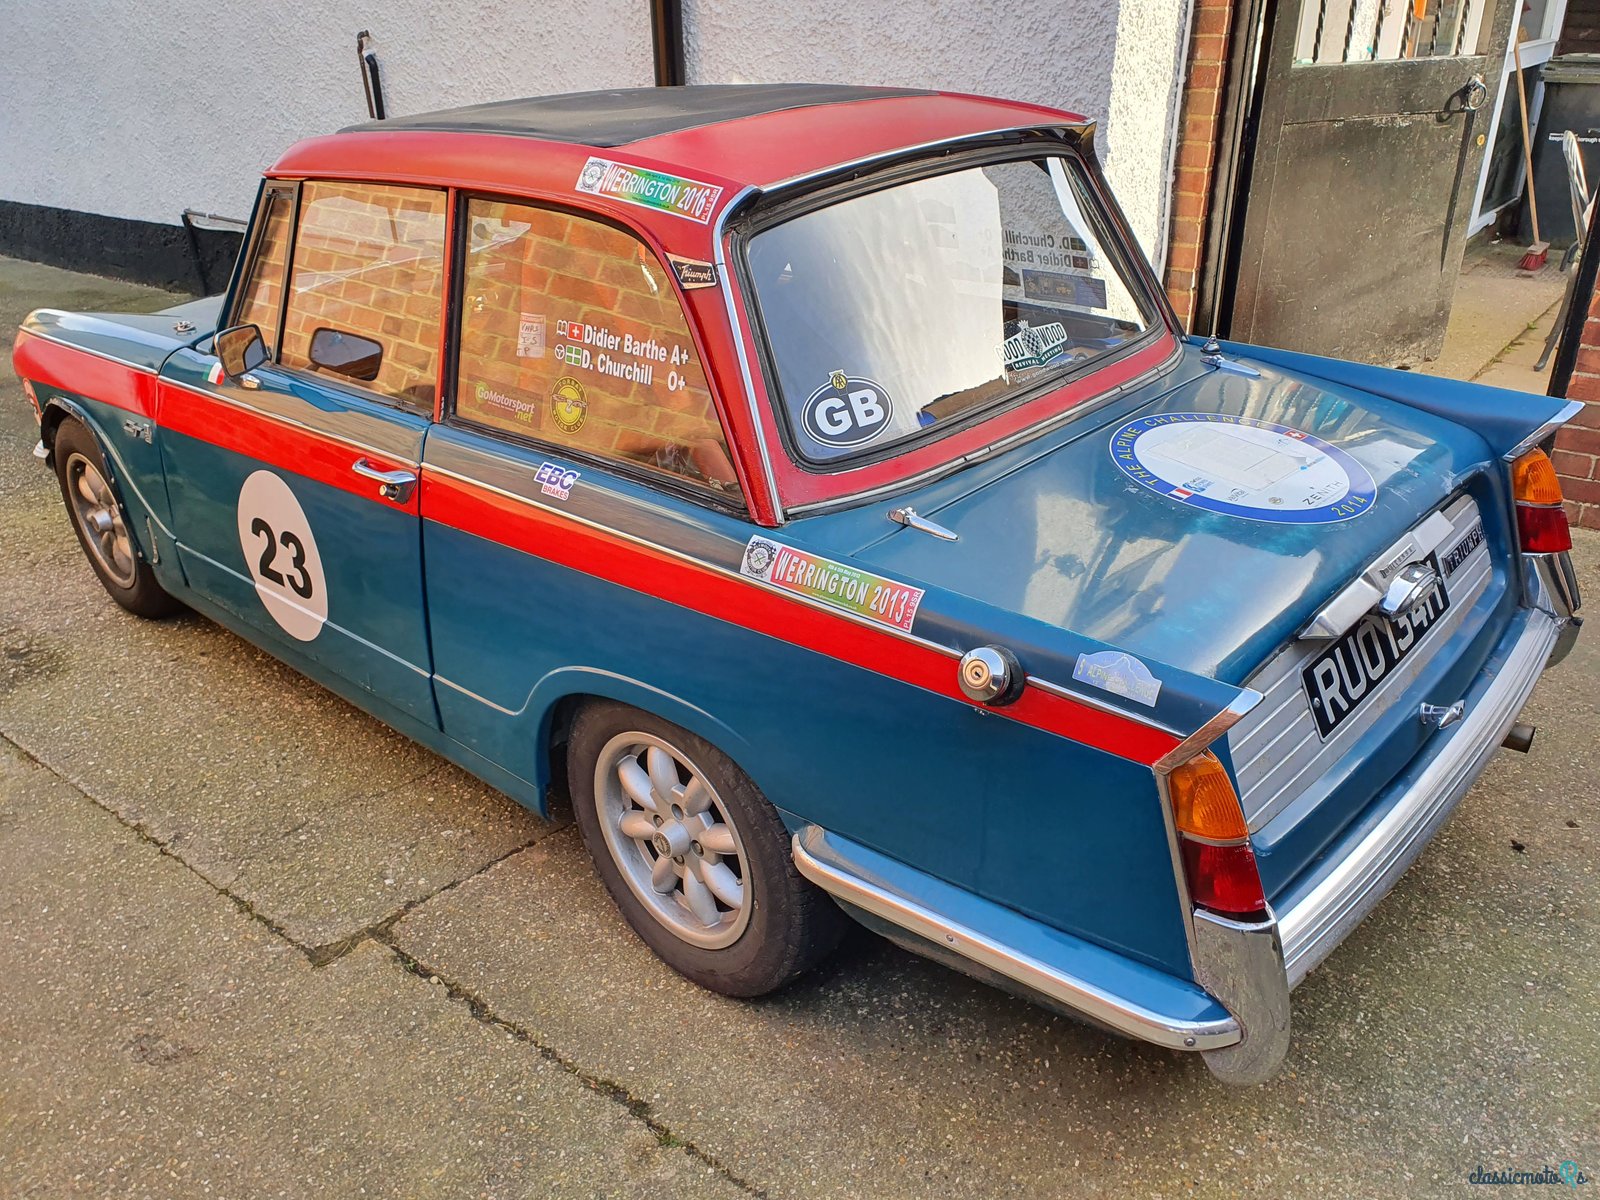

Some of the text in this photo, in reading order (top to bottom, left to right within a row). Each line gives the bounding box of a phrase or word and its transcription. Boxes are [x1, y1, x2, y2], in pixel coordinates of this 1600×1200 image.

[601, 163, 681, 205] WERRINGTON
[677, 186, 710, 217] 2016
[681, 265, 712, 281] Triumph
[583, 324, 689, 366] Didier Barthe A+
[582, 350, 594, 371] D.
[597, 353, 652, 385] Churchill
[1015, 359, 1040, 368] REVIVAL
[476, 386, 536, 414] GoMotorsport
[815, 388, 884, 435] GB
[1143, 413, 1266, 429] CHALLENGE
[1116, 427, 1142, 461] ALPINE
[1127, 464, 1156, 487] THE
[542, 484, 569, 501] BRAKES
[1302, 480, 1344, 506] ZENITH
[1331, 494, 1367, 517] 2014
[251, 517, 313, 599] 23
[1448, 523, 1485, 571] TRIUMPH
[774, 550, 909, 623] WERRINGTON 2013
